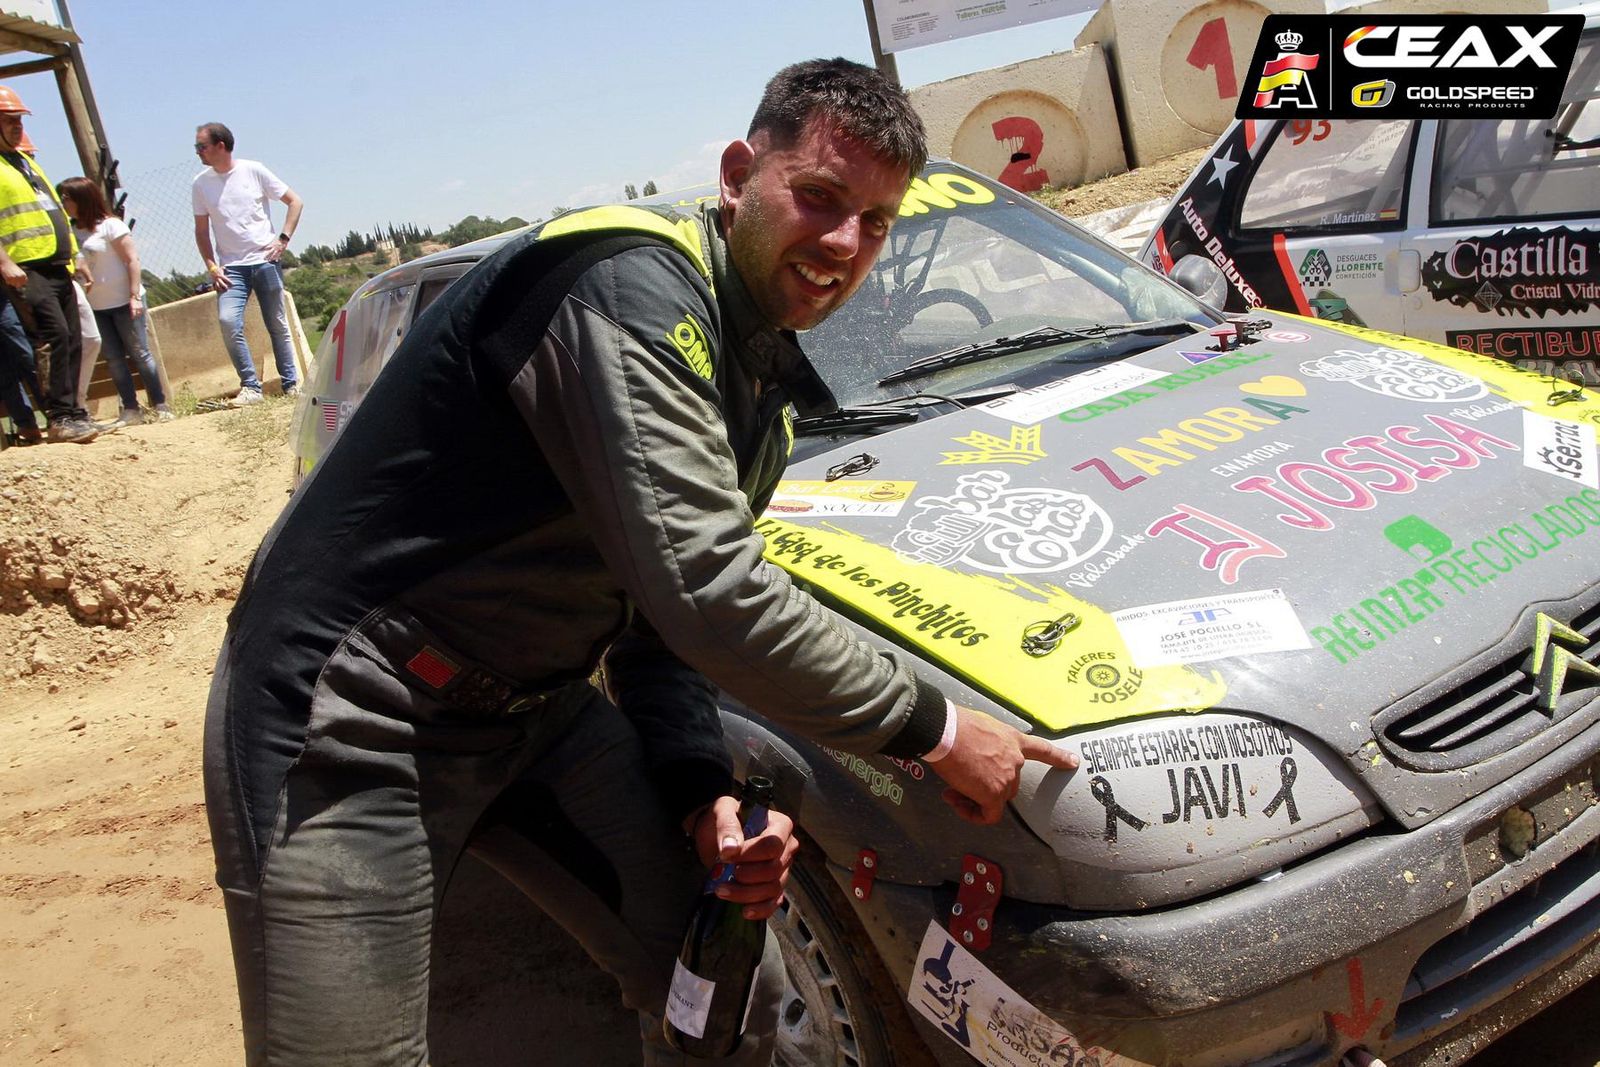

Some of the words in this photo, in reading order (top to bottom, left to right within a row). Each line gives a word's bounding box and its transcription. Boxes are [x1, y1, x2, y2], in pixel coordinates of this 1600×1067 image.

[1186, 17, 1238, 99] 1
[992, 116, 1049, 192] 2
[1179, 197, 1208, 241] Auto
[1336, 253, 1377, 262] DESGUACES
[1336, 262, 1384, 273] LLORENTE
[1445, 235, 1590, 282] Castilla
[1510, 283, 1561, 300] Cristal
[332, 310, 347, 383] 1
[673, 321, 713, 381] OMP
[1057, 388, 1160, 423] CAJA
[1150, 351, 1276, 391] RURAL
[1071, 397, 1310, 491] ZAMORA
[1210, 440, 1295, 478] ENAMORA
[1231, 414, 1521, 531] JOSISA
[773, 531, 823, 565] Casa
[813, 552, 846, 570] de
[840, 566, 882, 588] los
[873, 581, 990, 647] Pinchitos
[1311, 578, 1445, 665] REINZA
[1430, 489, 1600, 595] RECICLADOS
[1160, 631, 1187, 643] JOSE
[1190, 623, 1242, 637] POCIELLO
[1067, 651, 1117, 687] TALLERES
[1089, 665, 1144, 704] JOSELE
[1080, 734, 1142, 775] SIEMPRE
[1140, 728, 1201, 766] ESTARAS
[1198, 724, 1228, 761] CON
[1225, 721, 1294, 758] NOSOTROS
[1162, 763, 1246, 824] JAVI
